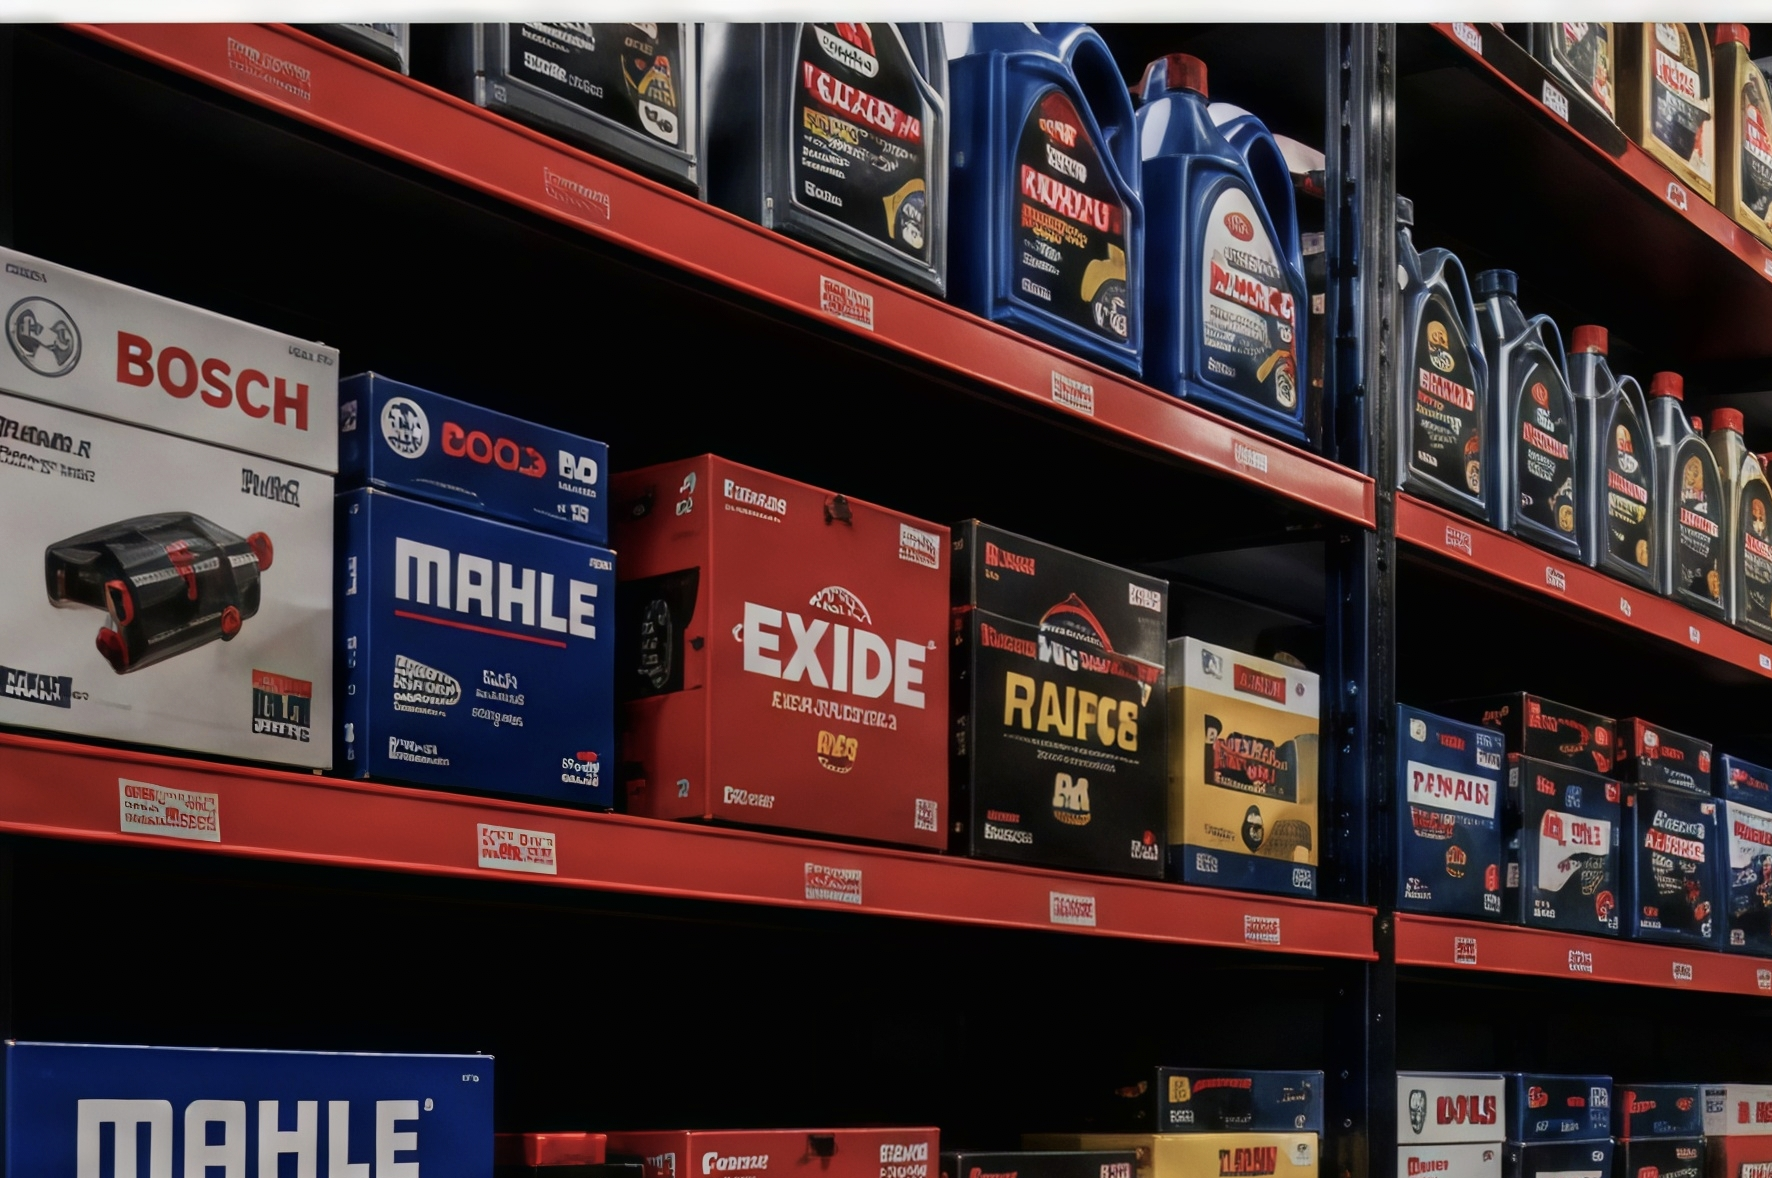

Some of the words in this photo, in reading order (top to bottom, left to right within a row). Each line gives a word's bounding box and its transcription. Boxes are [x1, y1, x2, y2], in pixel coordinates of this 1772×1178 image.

[117, 332, 309, 430] BOSCH
[394, 536, 599, 640] MAHLE
[743, 601, 926, 709] EXIDE
